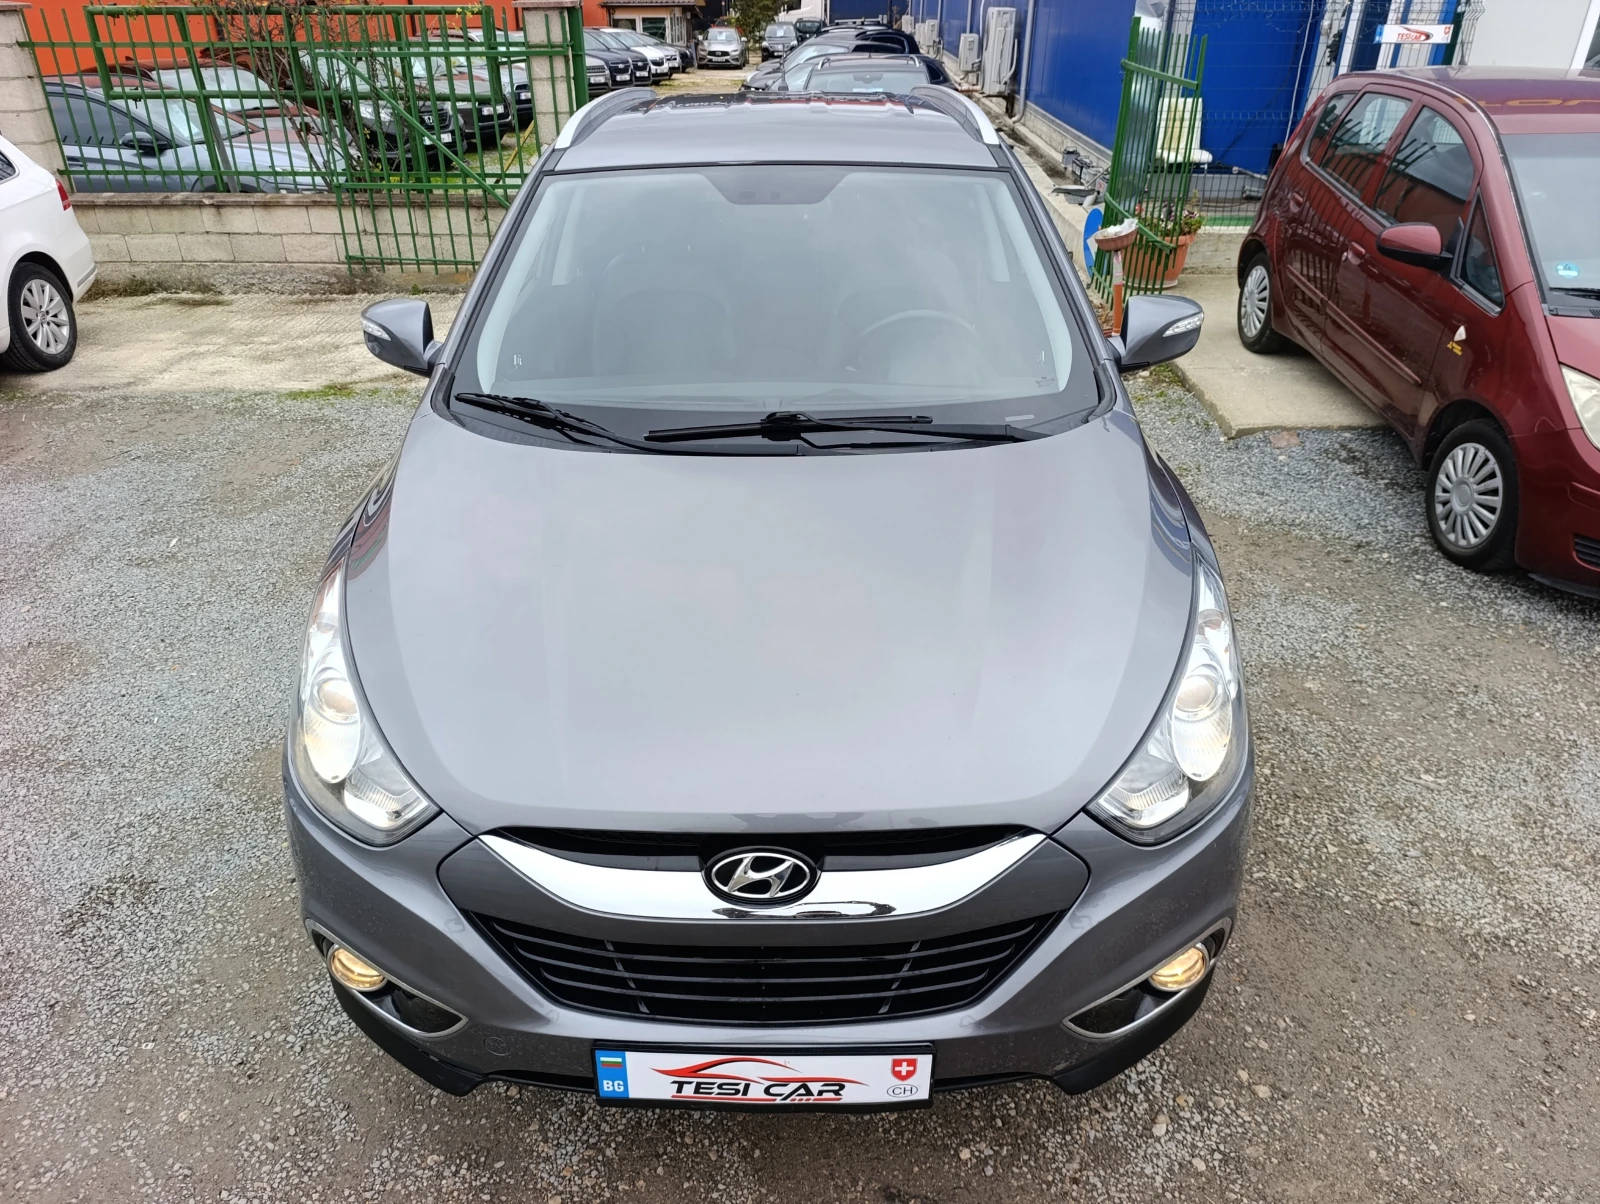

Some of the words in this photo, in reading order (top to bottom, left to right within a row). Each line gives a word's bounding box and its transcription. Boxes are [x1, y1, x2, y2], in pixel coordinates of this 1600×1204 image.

[603, 1080, 625, 1092] BG
[670, 1080, 751, 1097] TESI
[763, 1083, 846, 1101] CAR
[892, 1086, 914, 1096] CH
